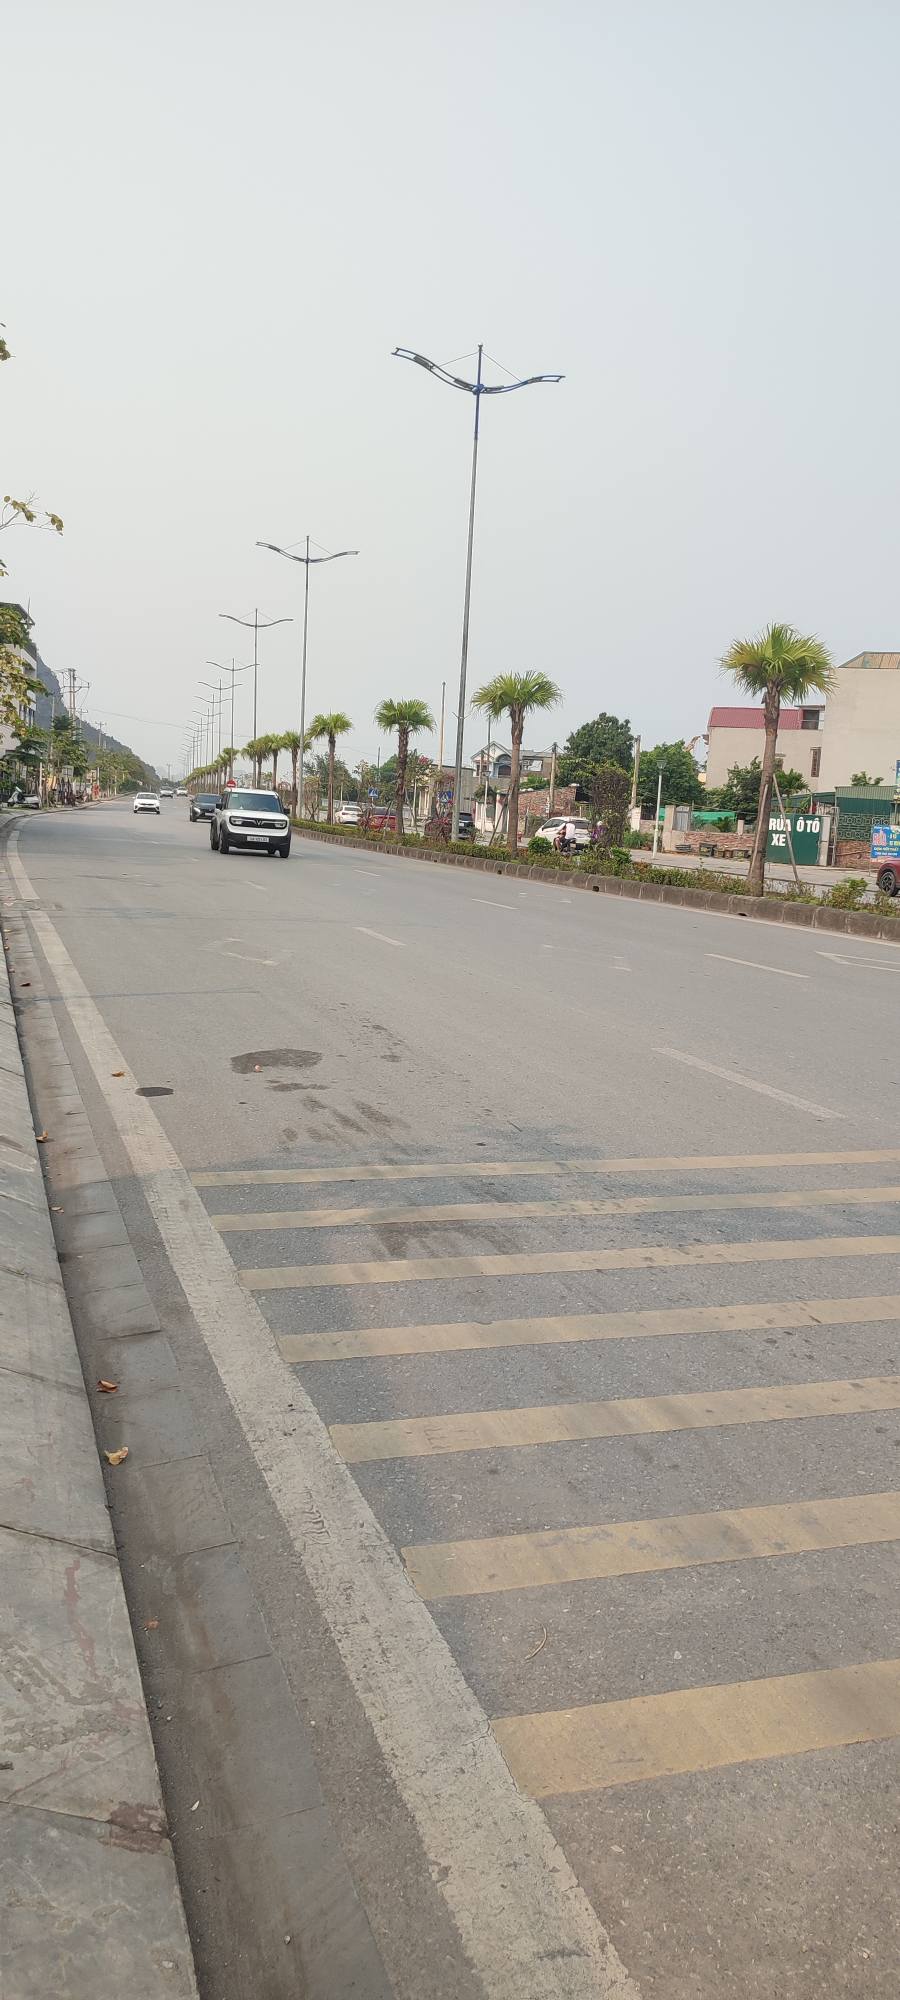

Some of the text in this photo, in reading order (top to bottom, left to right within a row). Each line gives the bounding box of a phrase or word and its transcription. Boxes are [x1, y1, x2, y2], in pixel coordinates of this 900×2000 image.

[796, 816, 804, 832] Ô
[806, 818, 820, 833] TÔ
[771, 834, 786, 846] XE
